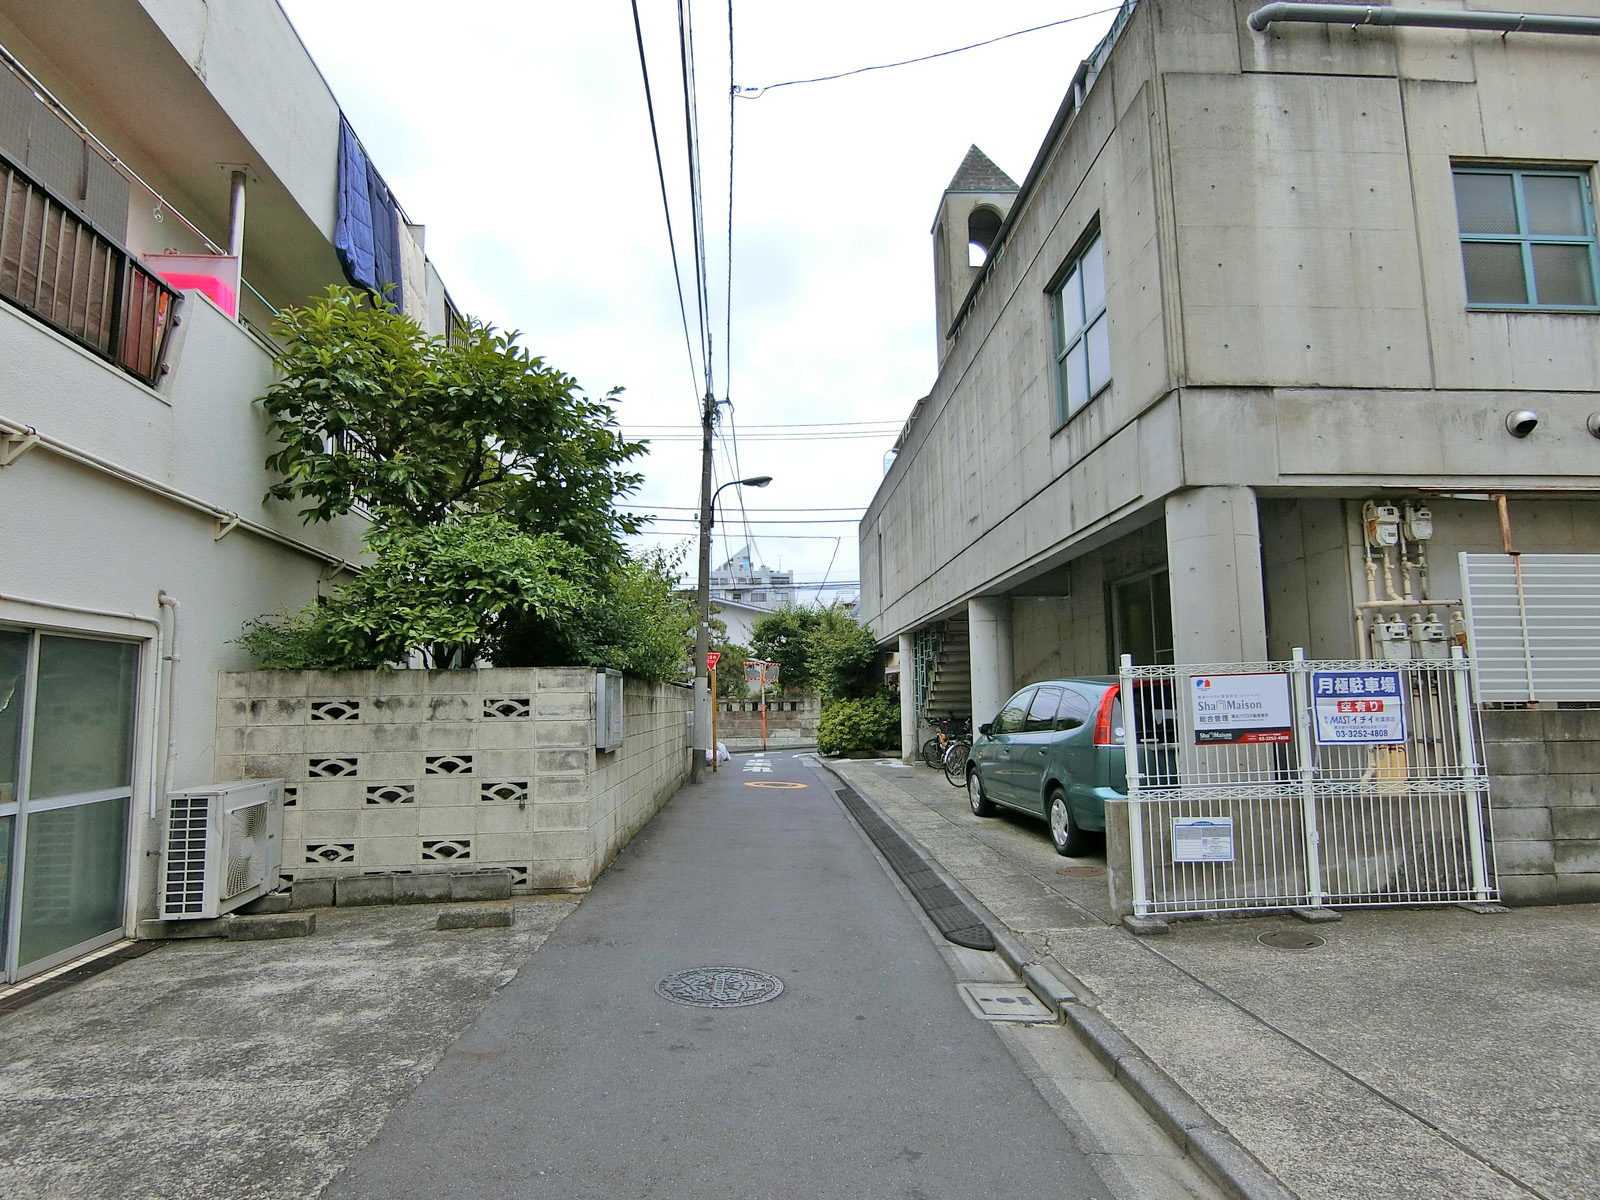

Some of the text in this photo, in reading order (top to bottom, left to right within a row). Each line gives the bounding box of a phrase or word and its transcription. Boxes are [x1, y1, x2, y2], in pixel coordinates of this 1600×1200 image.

[1317, 676, 1396, 694] 月極駐車場
[1198, 700, 1262, 711] Sha Maison
[1340, 701, 1379, 712] 空有り
[1335, 729, 1389, 738] 03-3252-4808
